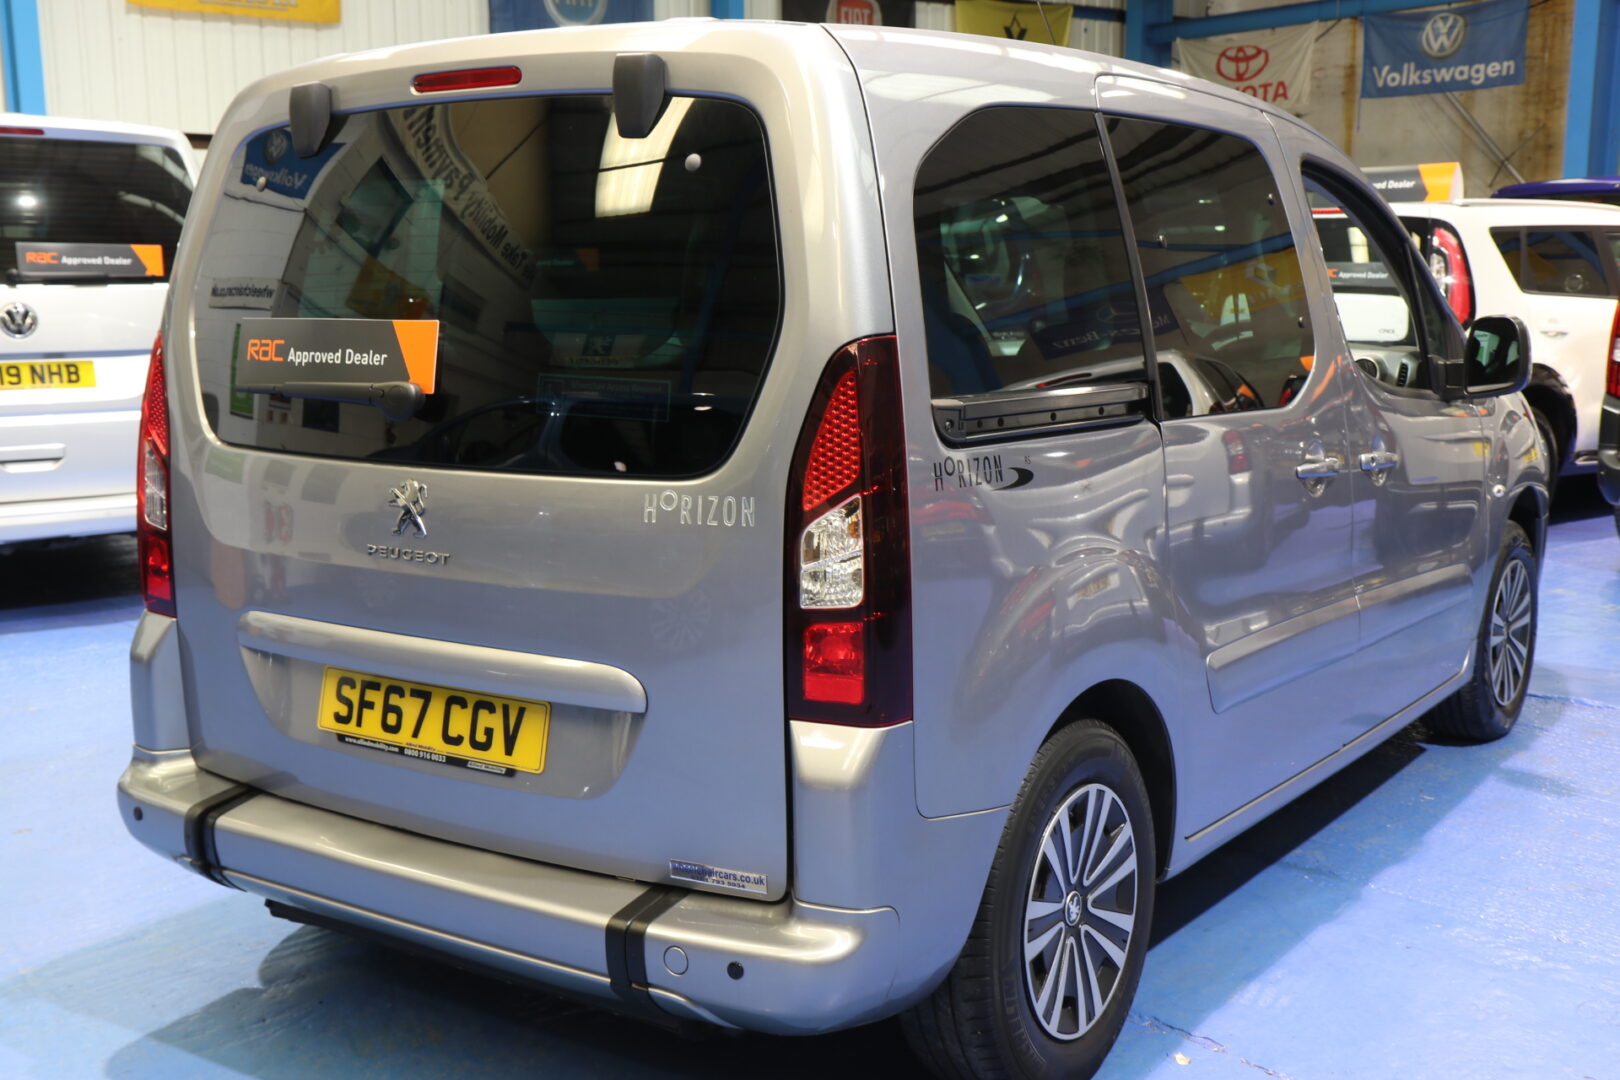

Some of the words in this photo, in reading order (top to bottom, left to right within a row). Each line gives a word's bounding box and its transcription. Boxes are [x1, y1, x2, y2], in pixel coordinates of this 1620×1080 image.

[841, 6, 871, 25] FIAT
[1372, 57, 1516, 89] Volkswagen
[1388, 179, 1416, 190] Dealer
[61, 255, 103, 266] Approved
[103, 256, 133, 266] Dealer
[1338, 272, 1366, 281] Approved
[287, 347, 341, 367] Approved
[345, 349, 388, 366] Dealer
[30, 363, 81, 386] NHB
[933, 454, 1004, 492] HORIZON
[643, 489, 756, 528] HORIZON
[367, 543, 451, 565] PEUGEOT
[333, 675, 433, 739] SF67
[441, 694, 527, 757] CGV
[419, 751, 431, 760] 916
